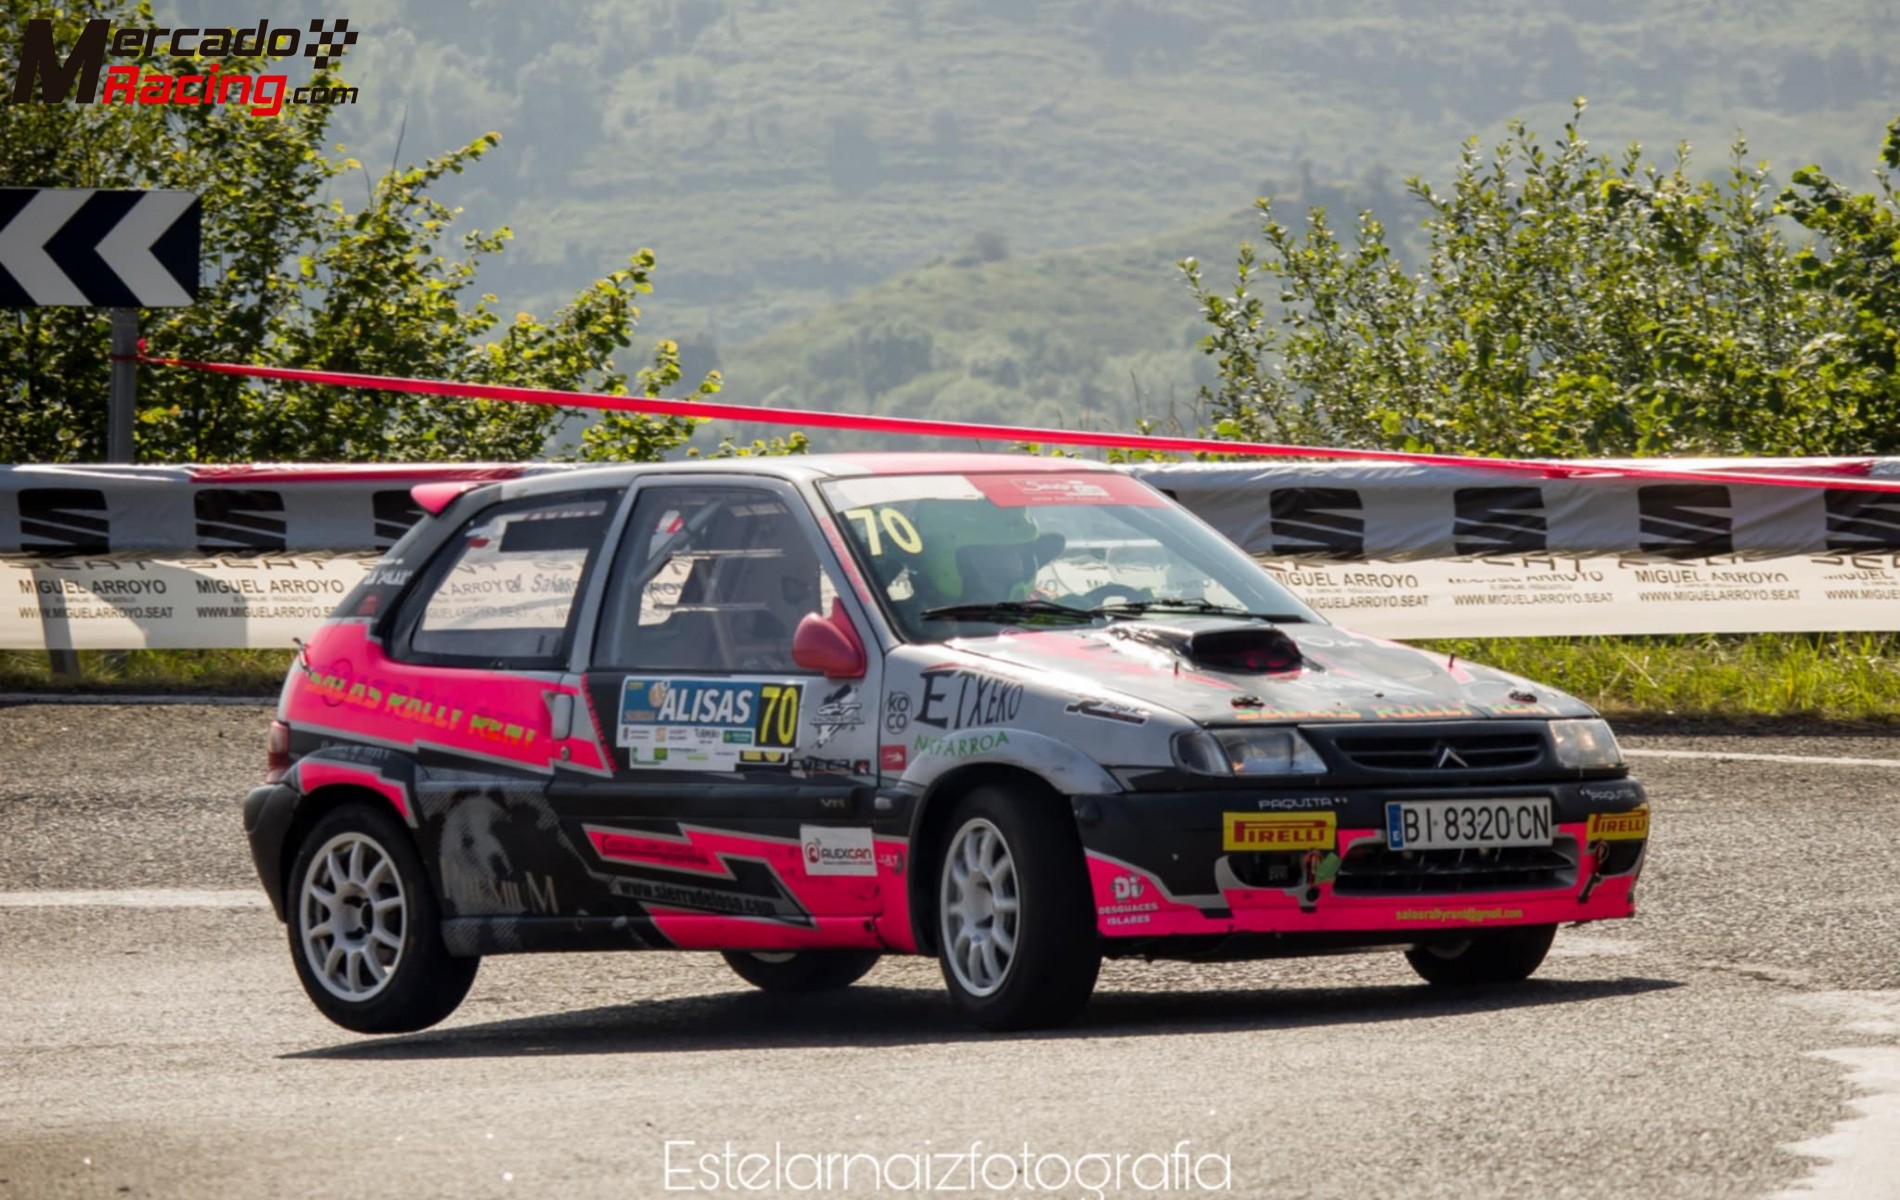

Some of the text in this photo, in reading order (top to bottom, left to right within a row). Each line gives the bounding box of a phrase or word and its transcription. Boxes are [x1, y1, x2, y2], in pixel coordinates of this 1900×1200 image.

[844, 507, 923, 558] 70
[1343, 573, 1419, 589] ARROYO
[1635, 569, 1789, 584] MIGUEL ARROYO
[18, 579, 167, 594] MIGUEL ARROYO
[195, 579, 344, 594] MIGUEL ARROYO
[1453, 592, 1613, 605] WWW.MIGUELARROYO.SEAT
[1639, 589, 1801, 602] WWW.MIGUELARROYO.SEAT
[19, 606, 173, 619] WWW.MIGUELARROYO.SEAT
[914, 669, 1024, 729] ETXEKO
[657, 686, 799, 744] ALISAS 70
[886, 713, 907, 730] CO
[1444, 806, 1511, 842] 8320
[1516, 804, 1549, 840] CN
[1593, 809, 1648, 833] PIRELLI
[1234, 820, 1327, 843] PIRELLI
[1098, 902, 1158, 916] DESGUACES
[1107, 914, 1150, 926] ISLARES
